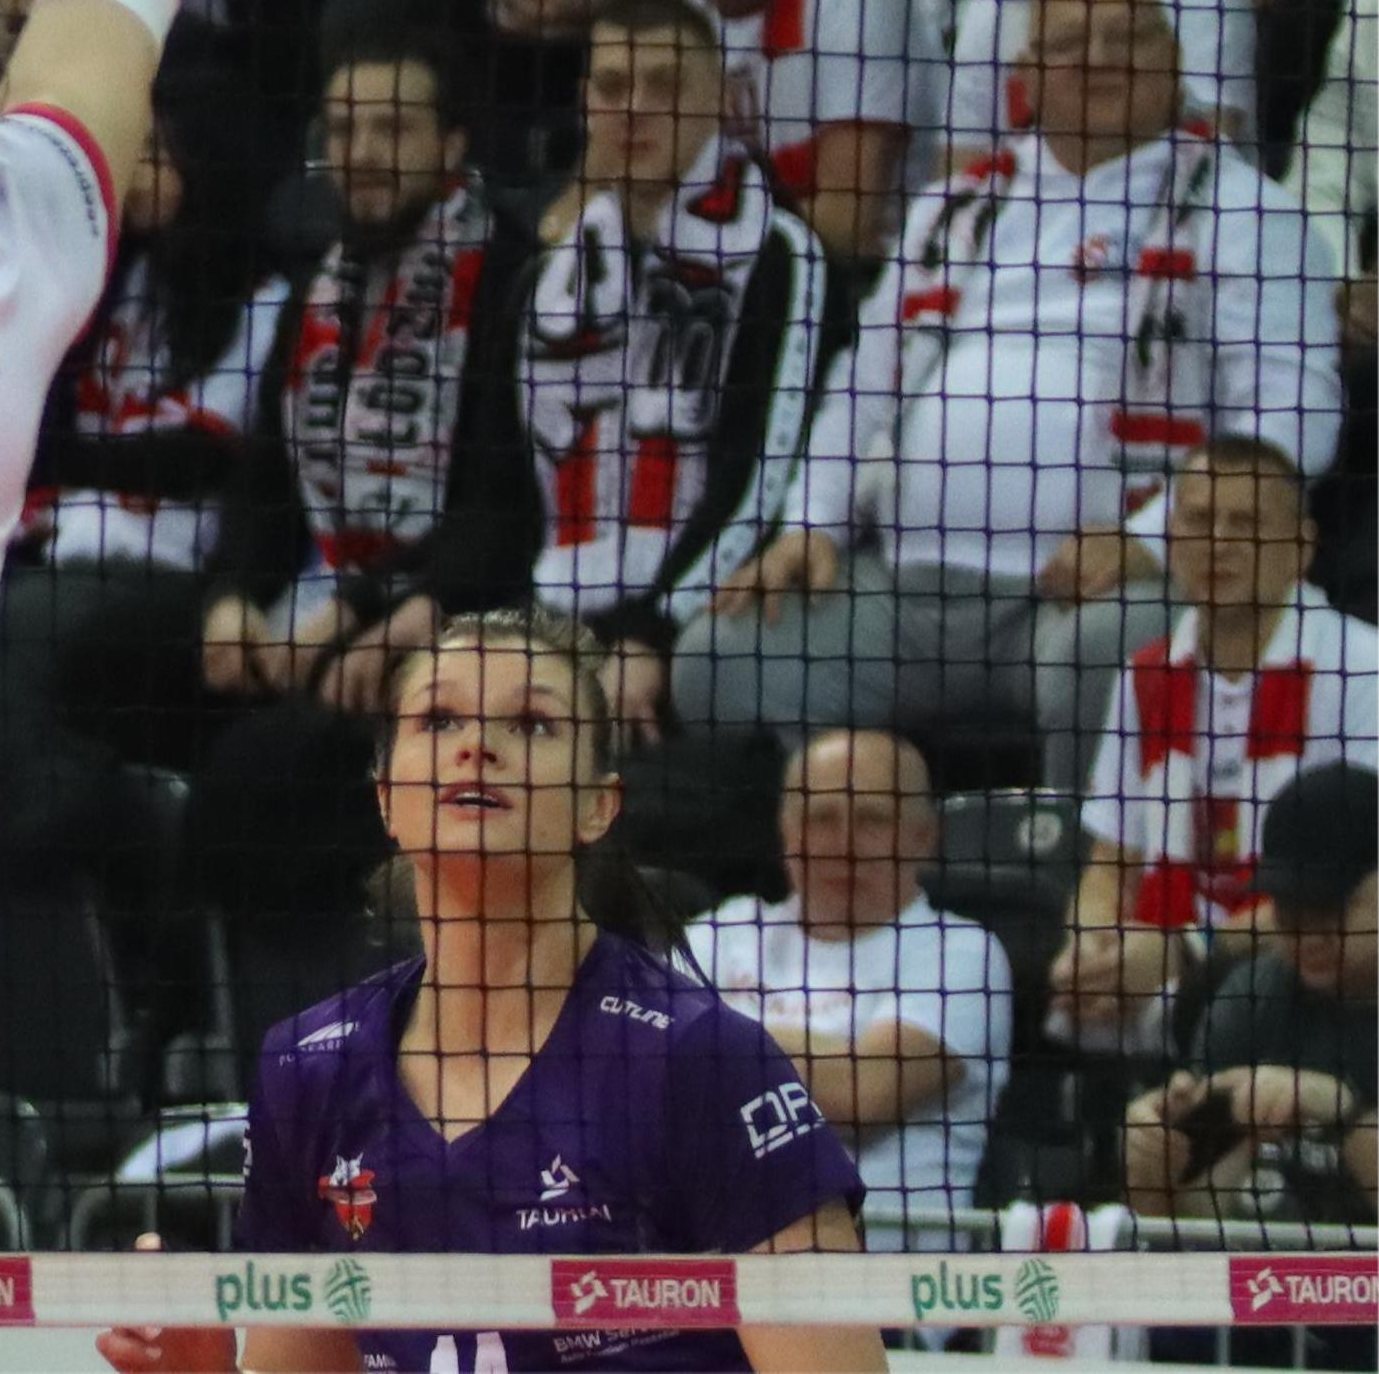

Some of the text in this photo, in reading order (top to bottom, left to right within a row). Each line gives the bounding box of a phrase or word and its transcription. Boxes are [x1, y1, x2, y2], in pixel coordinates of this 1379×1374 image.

[215, 1261, 312, 1319] plus
[610, 1277, 721, 1309] TAURON
[911, 1261, 1004, 1320] plus
